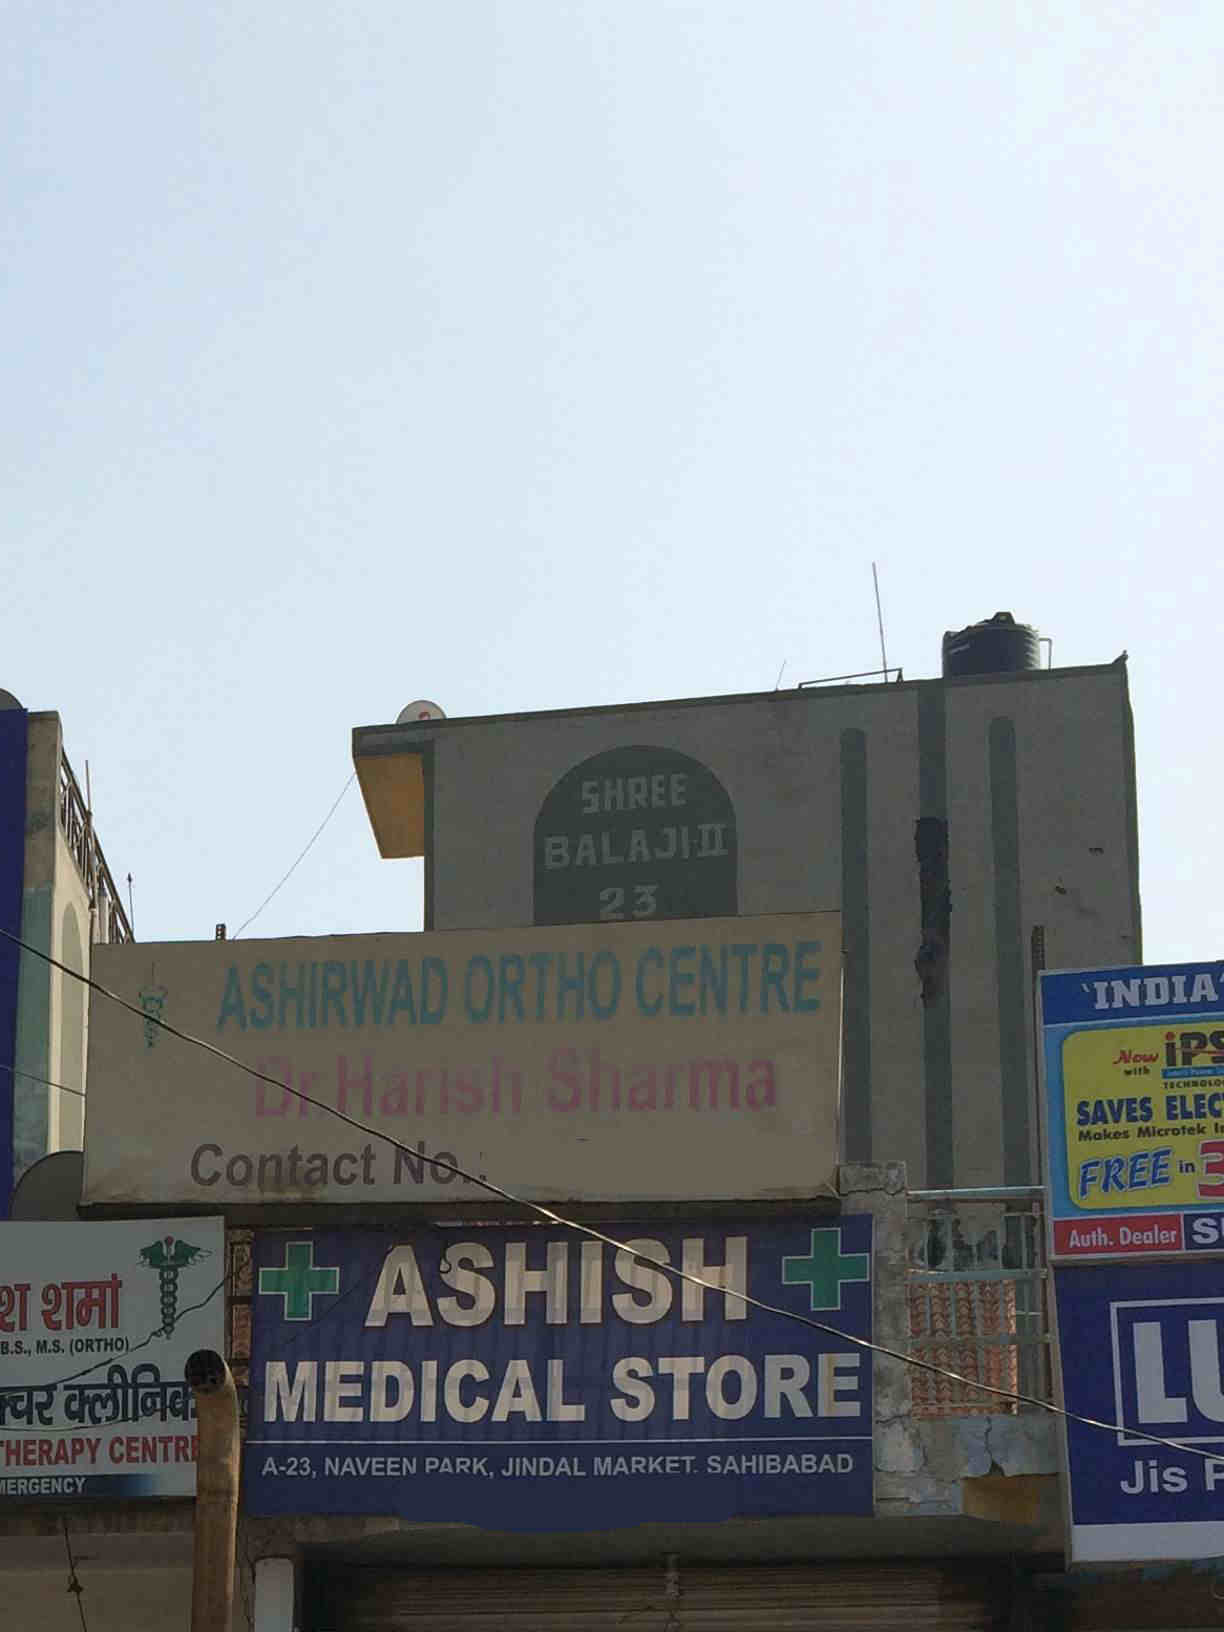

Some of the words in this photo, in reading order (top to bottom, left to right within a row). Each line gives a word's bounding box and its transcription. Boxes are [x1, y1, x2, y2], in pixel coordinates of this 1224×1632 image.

[581, 772, 688, 814] SHREE
[598, 884, 659, 919] 23
[217, 956, 449, 1033] ASHIRWAD
[464, 949, 622, 1025] ORTHO
[635, 940, 823, 1017] CENTRE
[1112, 1049, 1159, 1064] Now
[1124, 1066, 1150, 1076] with
[546, 1049, 777, 1112] Sharma
[1077, 1096, 1152, 1126] SAVES
[1078, 1128, 1130, 1142] Makes
[1137, 1122, 1207, 1138] Microtek
[189, 1142, 377, 1187] Contact
[1078, 1147, 1173, 1200] FREE
[1179, 1160, 1195, 1174] in
[1069, 1226, 1114, 1248] Auth.
[1119, 1223, 1177, 1246] Dealer
[364, 1236, 748, 1329] ASHISH
[36, 1339, 65, 1355] M.S.
[70, 1336, 130, 1355] (ORTHO)
[263, 1358, 585, 1424] MEDICAL
[609, 1352, 863, 1420] STORE
[109, 1434, 198, 1464] CENTRE
[261, 1455, 317, 1479] A-23,
[323, 1456, 417, 1476] NAVEEN
[425, 1456, 494, 1479] PARK,
[501, 1455, 586, 1477] JINDAL
[706, 1453, 854, 1475] SAHIBABAD
[1120, 1458, 1188, 1494] Jis
